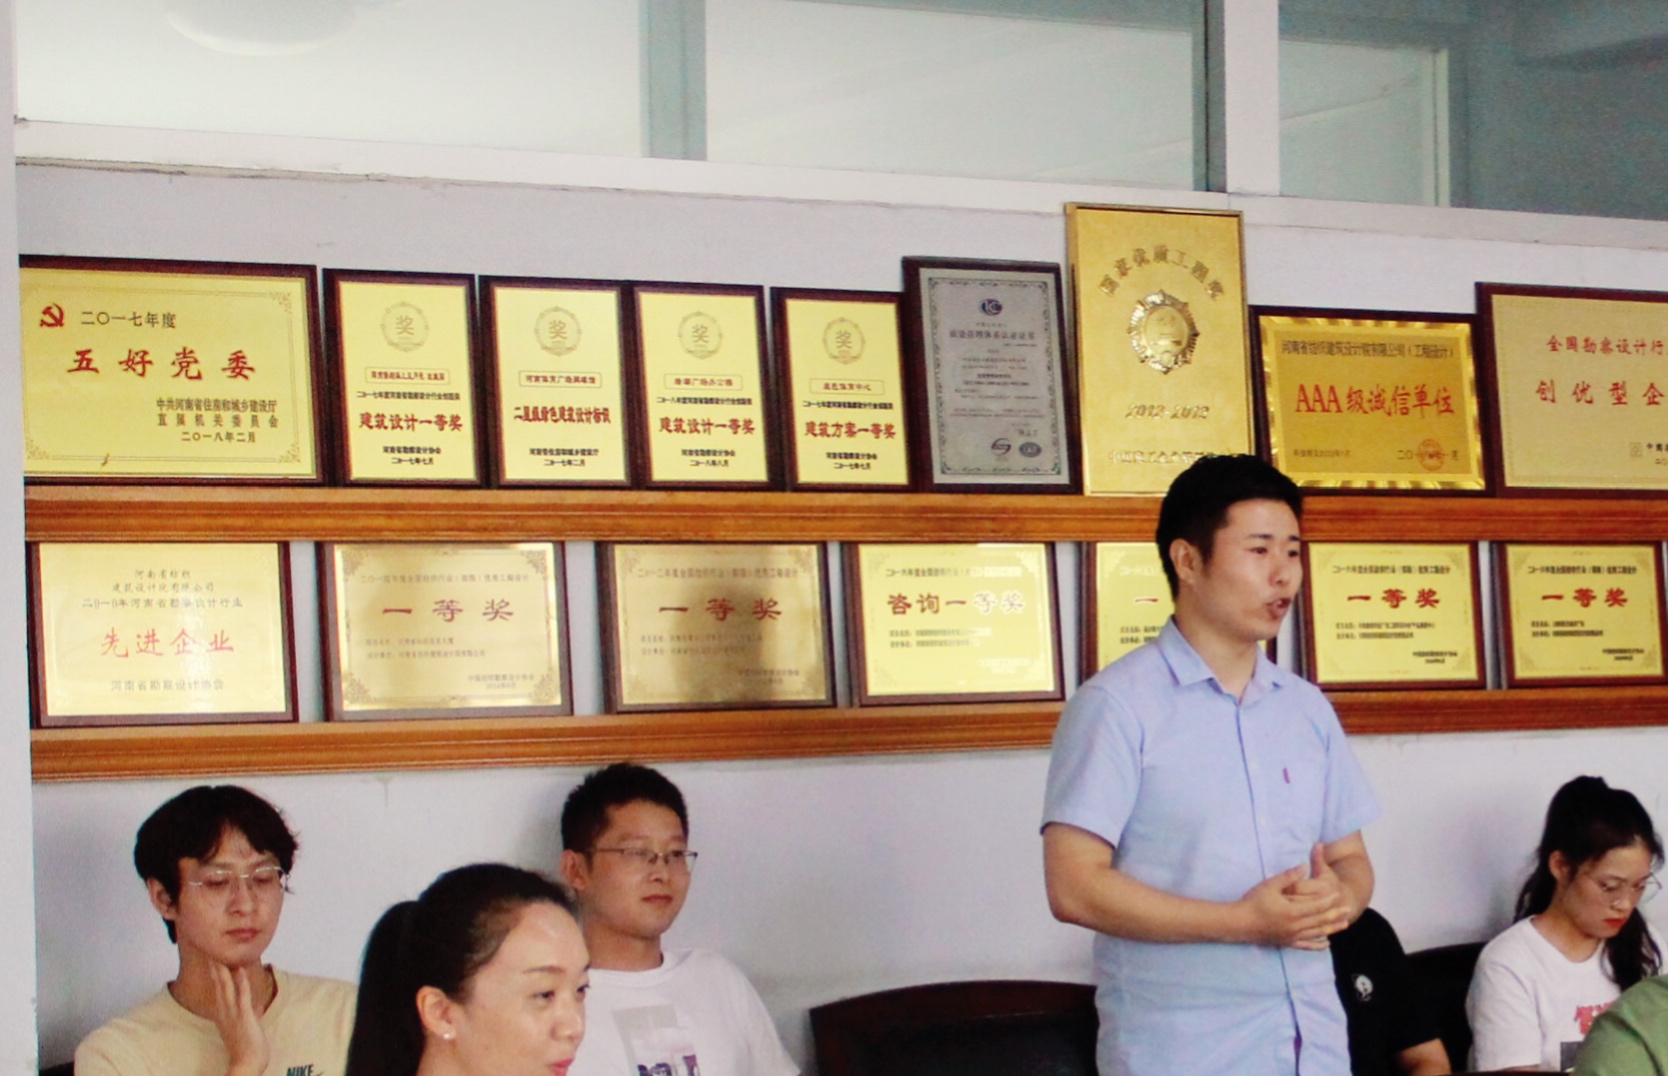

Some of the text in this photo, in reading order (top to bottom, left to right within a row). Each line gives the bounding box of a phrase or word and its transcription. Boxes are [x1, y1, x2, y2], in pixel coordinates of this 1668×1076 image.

[396, 315, 415, 336] 奖
[549, 320, 568, 341] 奖
[691, 324, 709, 344] 奖
[67, 346, 256, 380] 五好党委
[157, 414, 279, 428] 直属机关委员会
[358, 411, 464, 432] 建筑设计一等奖
[659, 417, 755, 435] 建筑设计一等奖
[805, 421, 896, 439] 建筑方案一等奖
[887, 592, 1024, 615] 咨询一等奖
[1347, 588, 1440, 609] 一等奖
[1541, 587, 1628, 608] 一等奖
[382, 599, 514, 623] 一等奖
[659, 597, 782, 621] 一等奖
[100, 627, 234, 658] 先进企业
